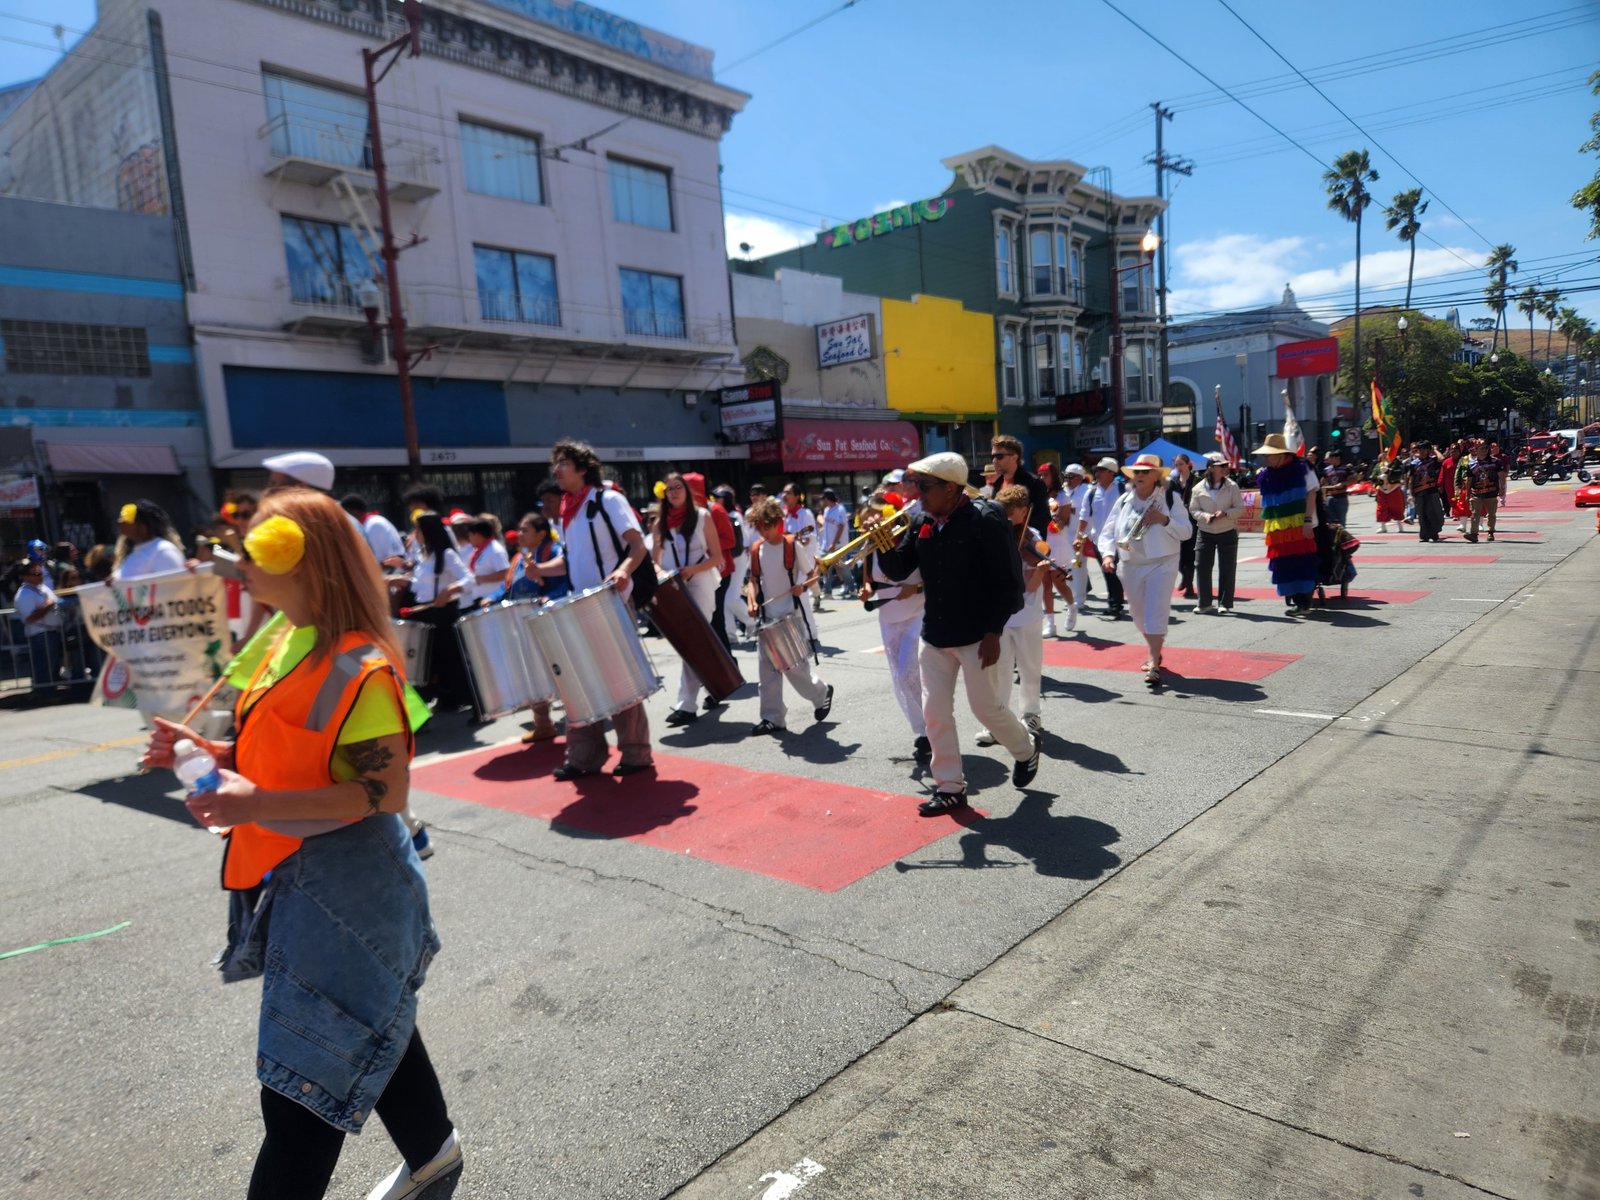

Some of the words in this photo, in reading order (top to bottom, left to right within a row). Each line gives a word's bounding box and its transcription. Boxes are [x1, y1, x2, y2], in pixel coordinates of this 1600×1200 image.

[822, 347, 855, 363] Seafood
[816, 439, 832, 452] Sun
[835, 439, 848, 452] Fat
[851, 439, 877, 451] Seafood
[1076, 436, 1106, 447] HOTEL
[168, 596, 217, 618] TODOS
[99, 630, 126, 647] MUSIC
[127, 628, 145, 645] FOR
[149, 620, 216, 642] EVERYONE
